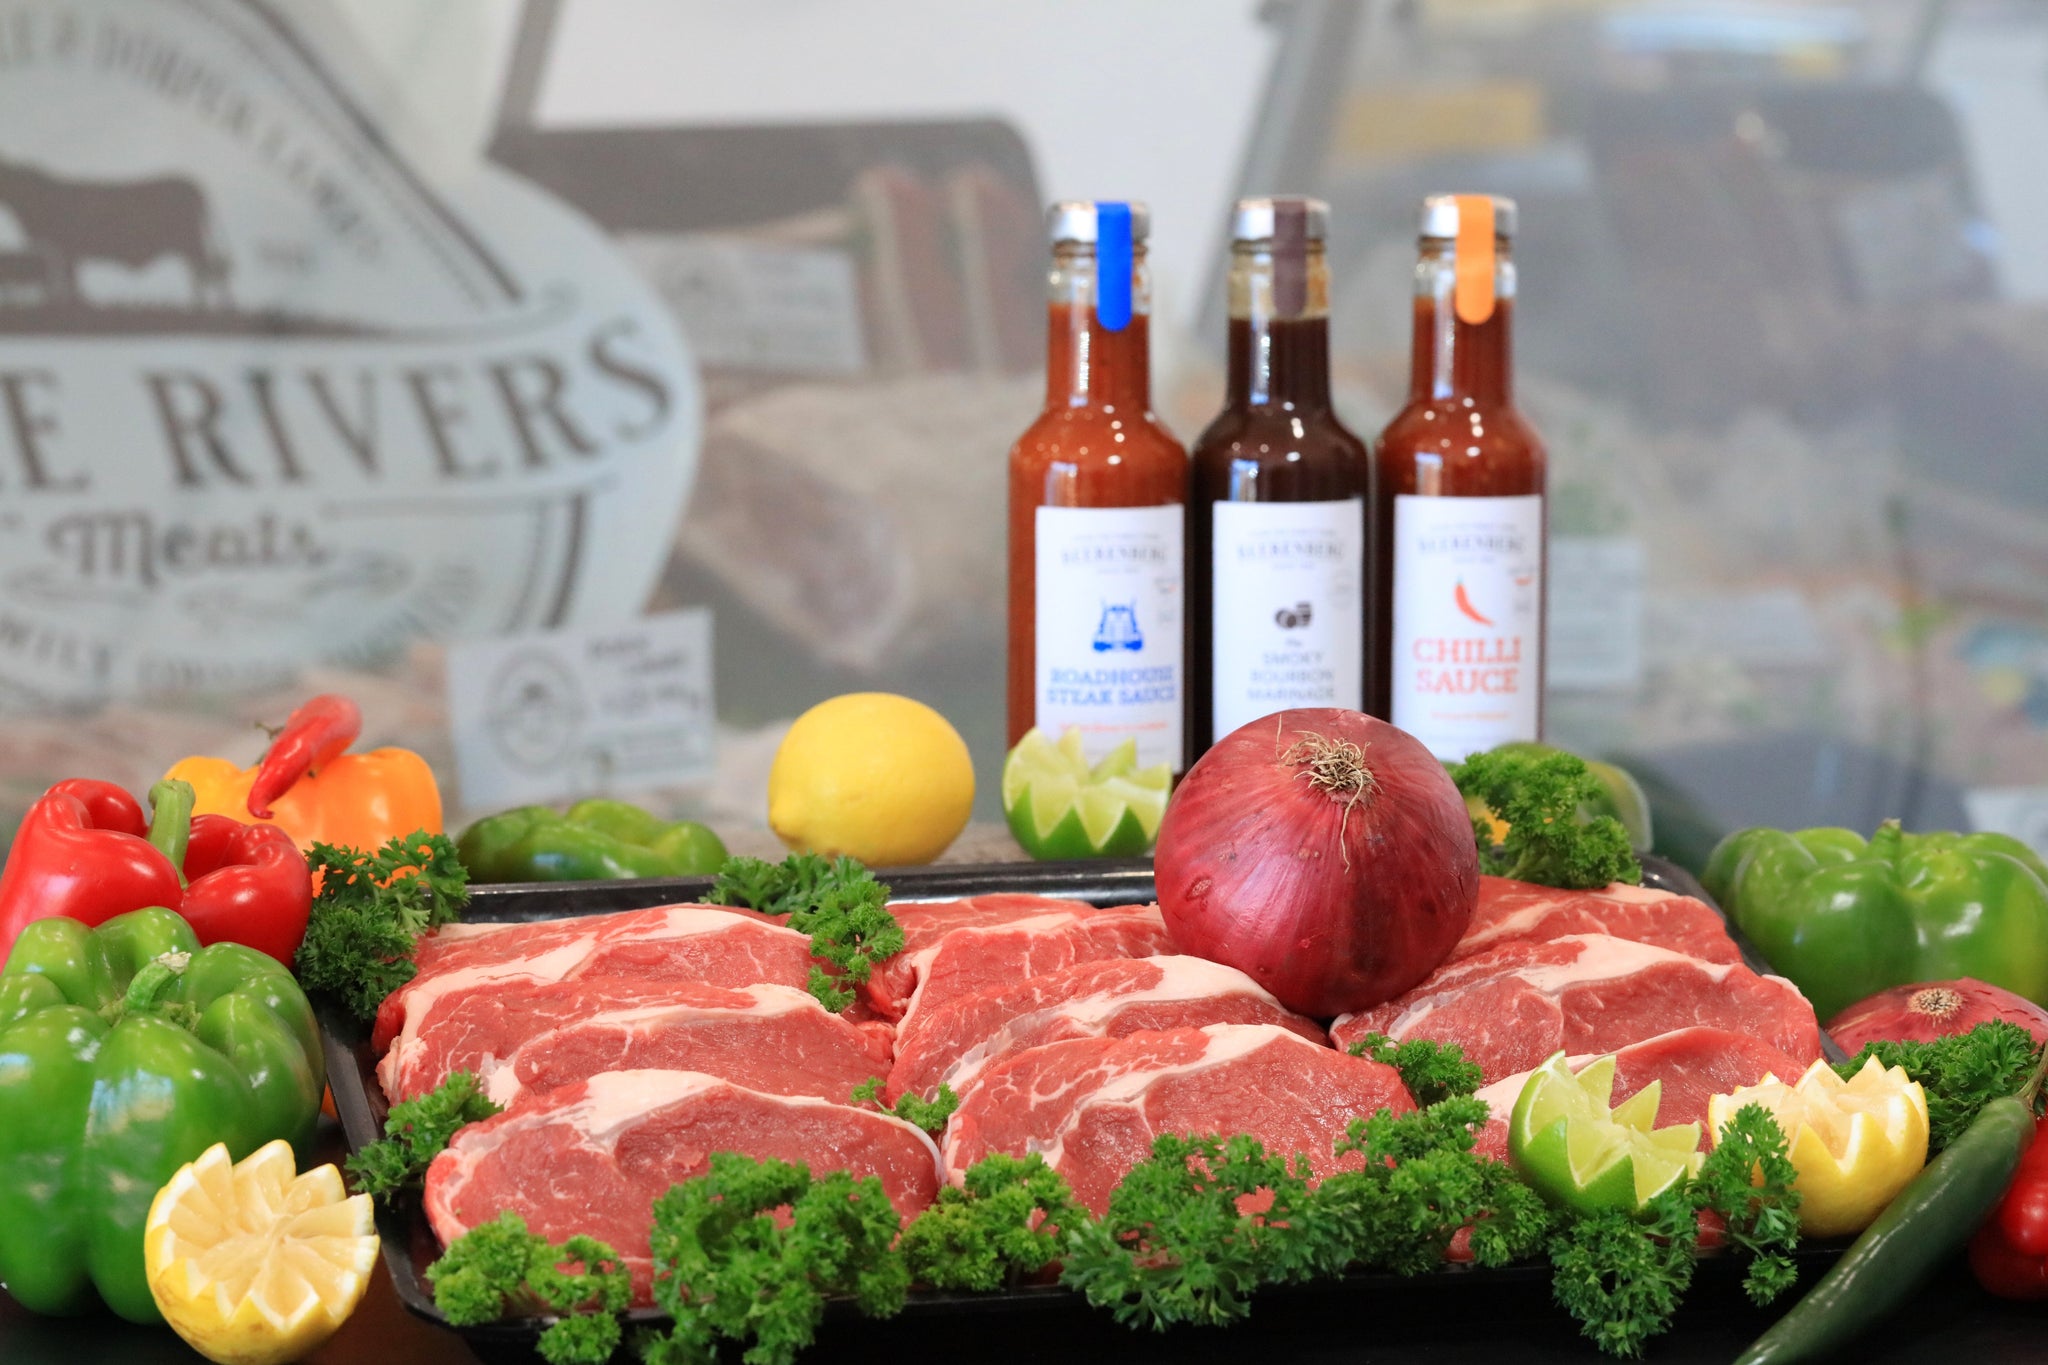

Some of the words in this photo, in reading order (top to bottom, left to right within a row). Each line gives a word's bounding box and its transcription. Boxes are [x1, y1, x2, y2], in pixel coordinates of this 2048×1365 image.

[143, 316, 672, 488] RIVERS
[46, 507, 332, 585] Meats
[1413, 636, 1522, 664] CHILLI
[1050, 667, 1174, 685] ROADHOUSE
[1415, 668, 1519, 694] SAUCE
[1047, 687, 1112, 706] STEAK
[1118, 685, 1176, 705] SAUCE
